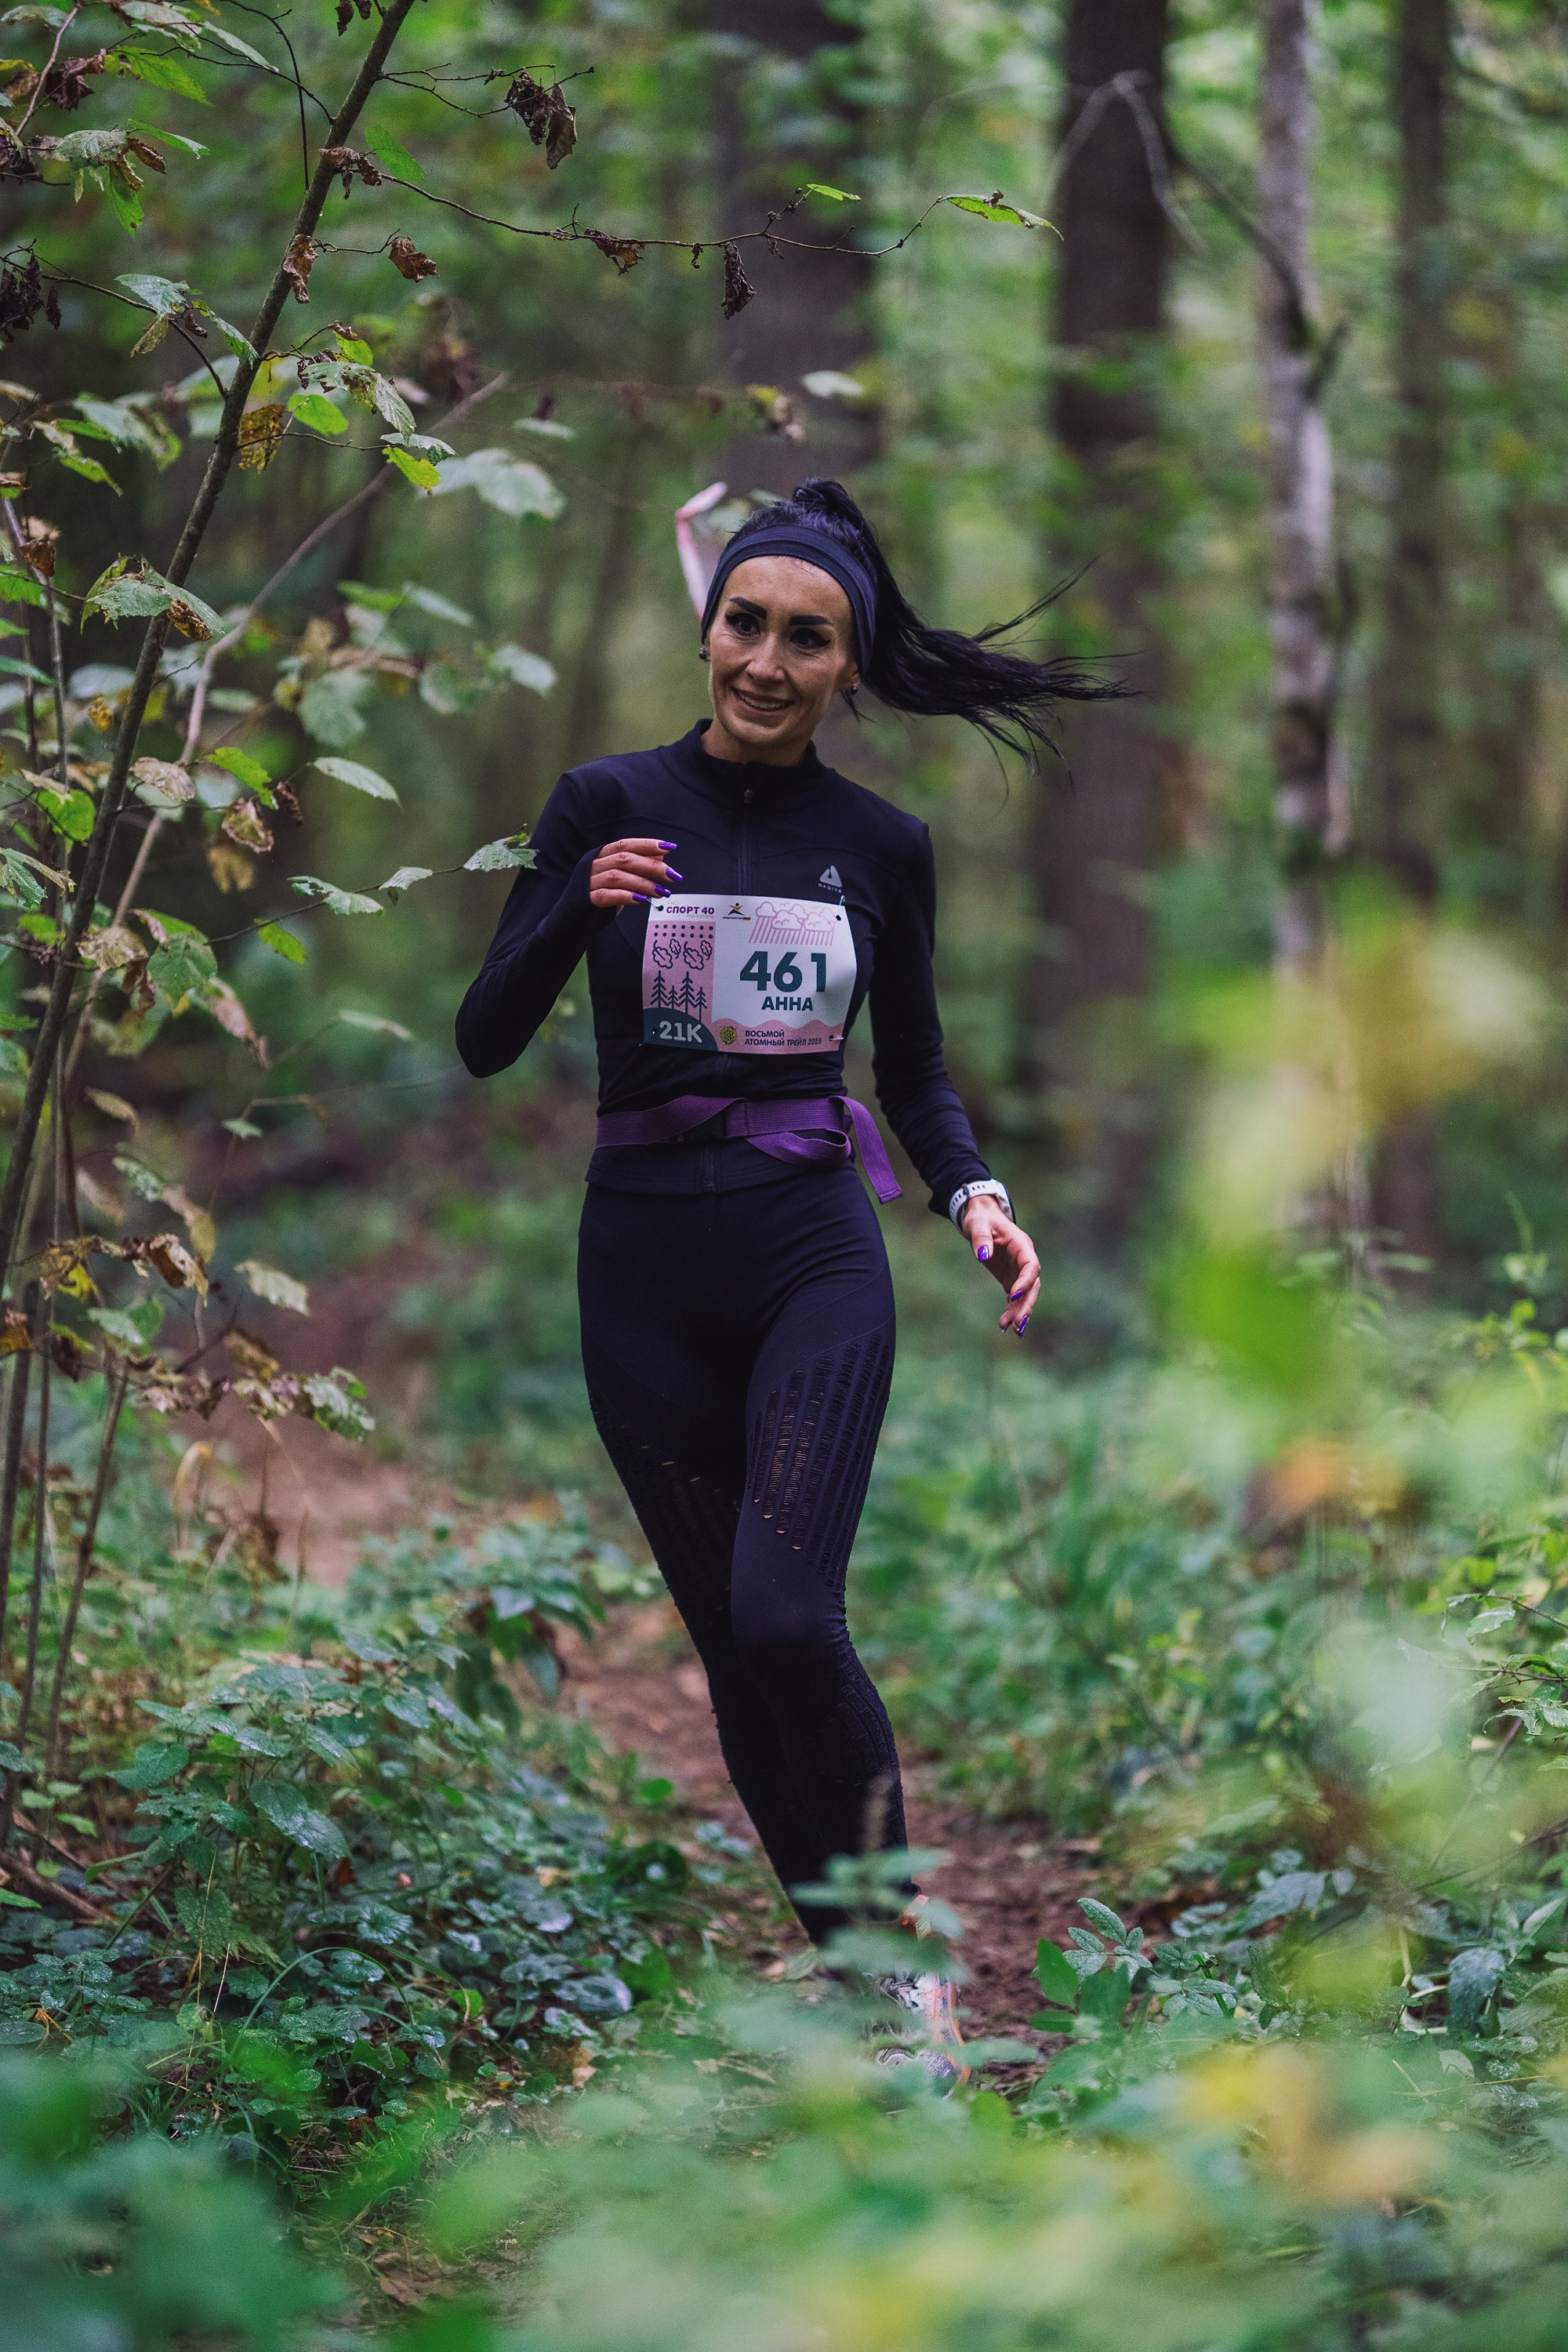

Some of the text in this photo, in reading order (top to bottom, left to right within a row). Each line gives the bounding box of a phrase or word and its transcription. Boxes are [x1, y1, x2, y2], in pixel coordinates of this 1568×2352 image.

[666, 906, 715, 915] СПОРТ 40
[739, 951, 827, 993] 461
[761, 996, 814, 1011] АННА
[745, 1029, 785, 1038] ВОСЬМОЙ
[744, 1037, 822, 1047] АТОМНЫЙ ТРЕЙЛ 2025
